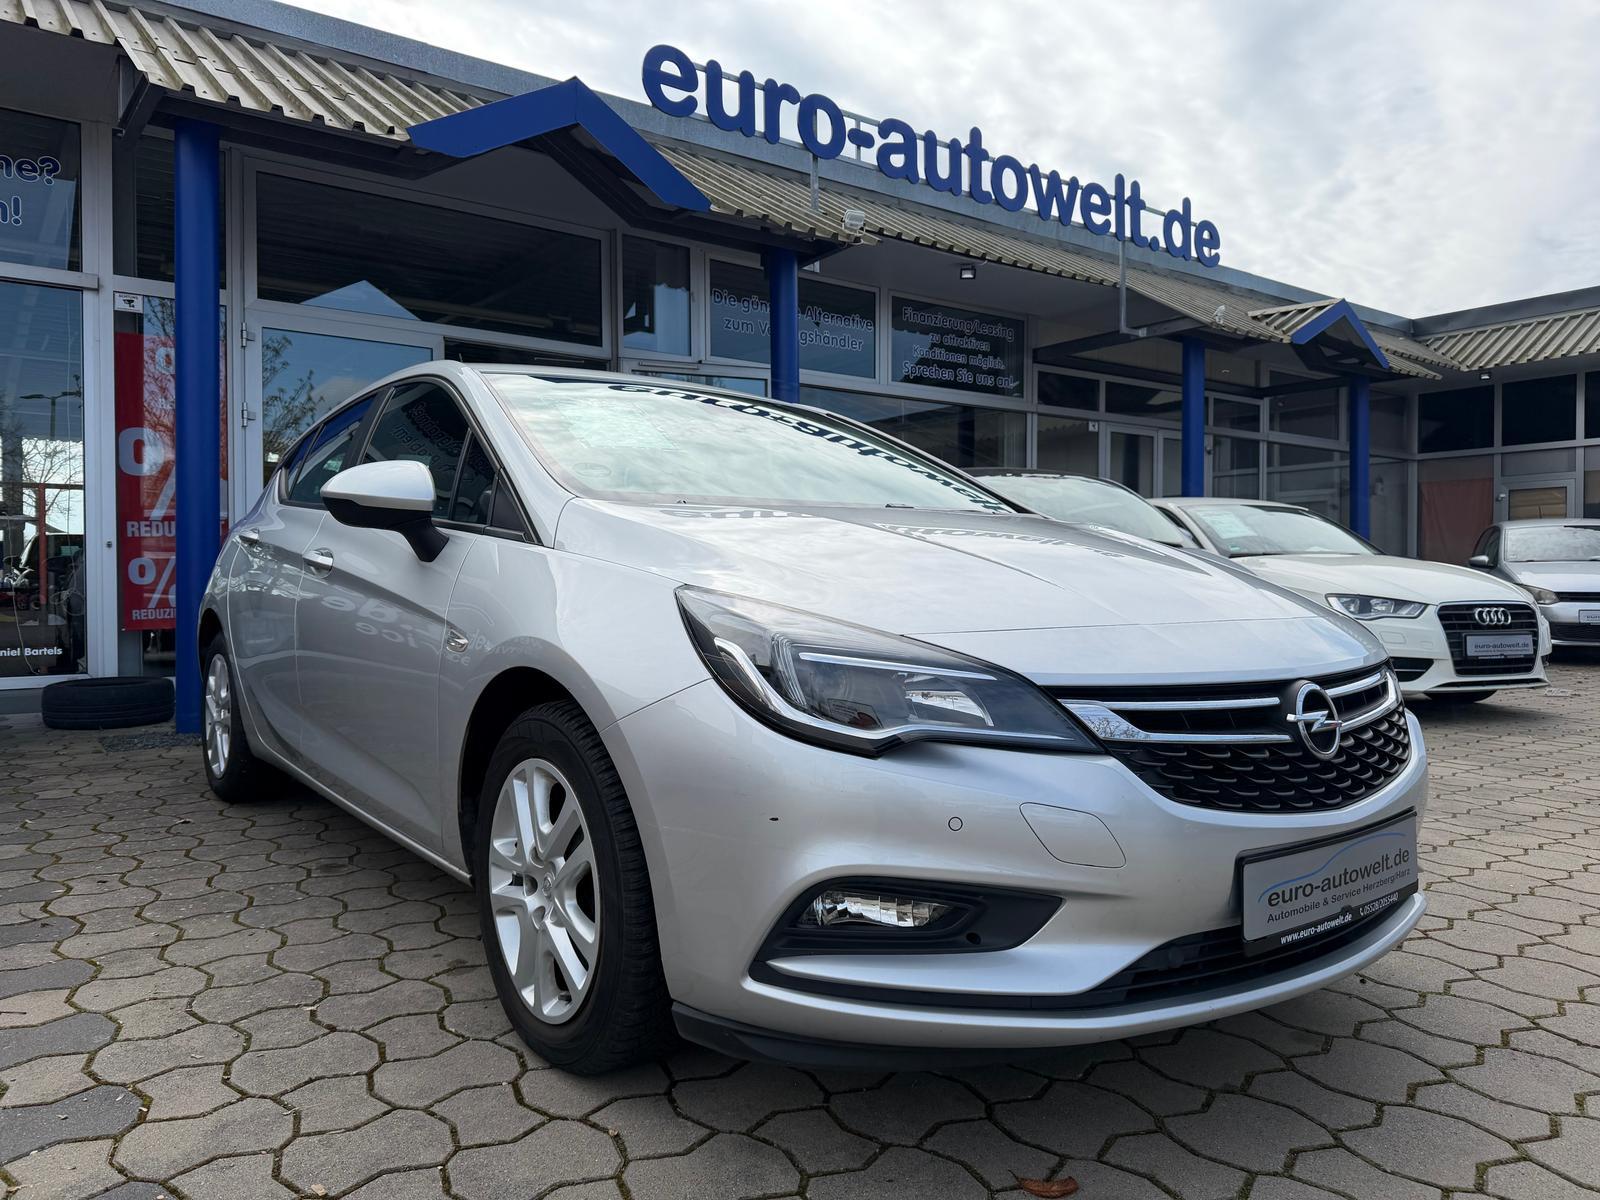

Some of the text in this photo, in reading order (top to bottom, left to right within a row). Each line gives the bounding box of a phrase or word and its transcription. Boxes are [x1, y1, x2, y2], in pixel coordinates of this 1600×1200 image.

[642, 44, 1220, 267] euro-autowelt.de
[712, 288, 738, 308] Die
[805, 305, 873, 331] Alternative
[724, 317, 755, 334] zum
[902, 306, 1015, 342] Finanzierung/Leasing
[912, 344, 967, 364] Konditionen
[928, 332, 991, 352] zu attraktiven
[902, 360, 1015, 389] Sprechen Sie uns an!
[24, 646, 63, 656] Bartels
[1267, 848, 1410, 907] euro-autowelt.de
[1266, 901, 1320, 924] Automobile
[1322, 898, 1329, 906] &
[1331, 888, 1361, 904] Service
[1280, 912, 1353, 945] www.euro-autowelt.de
